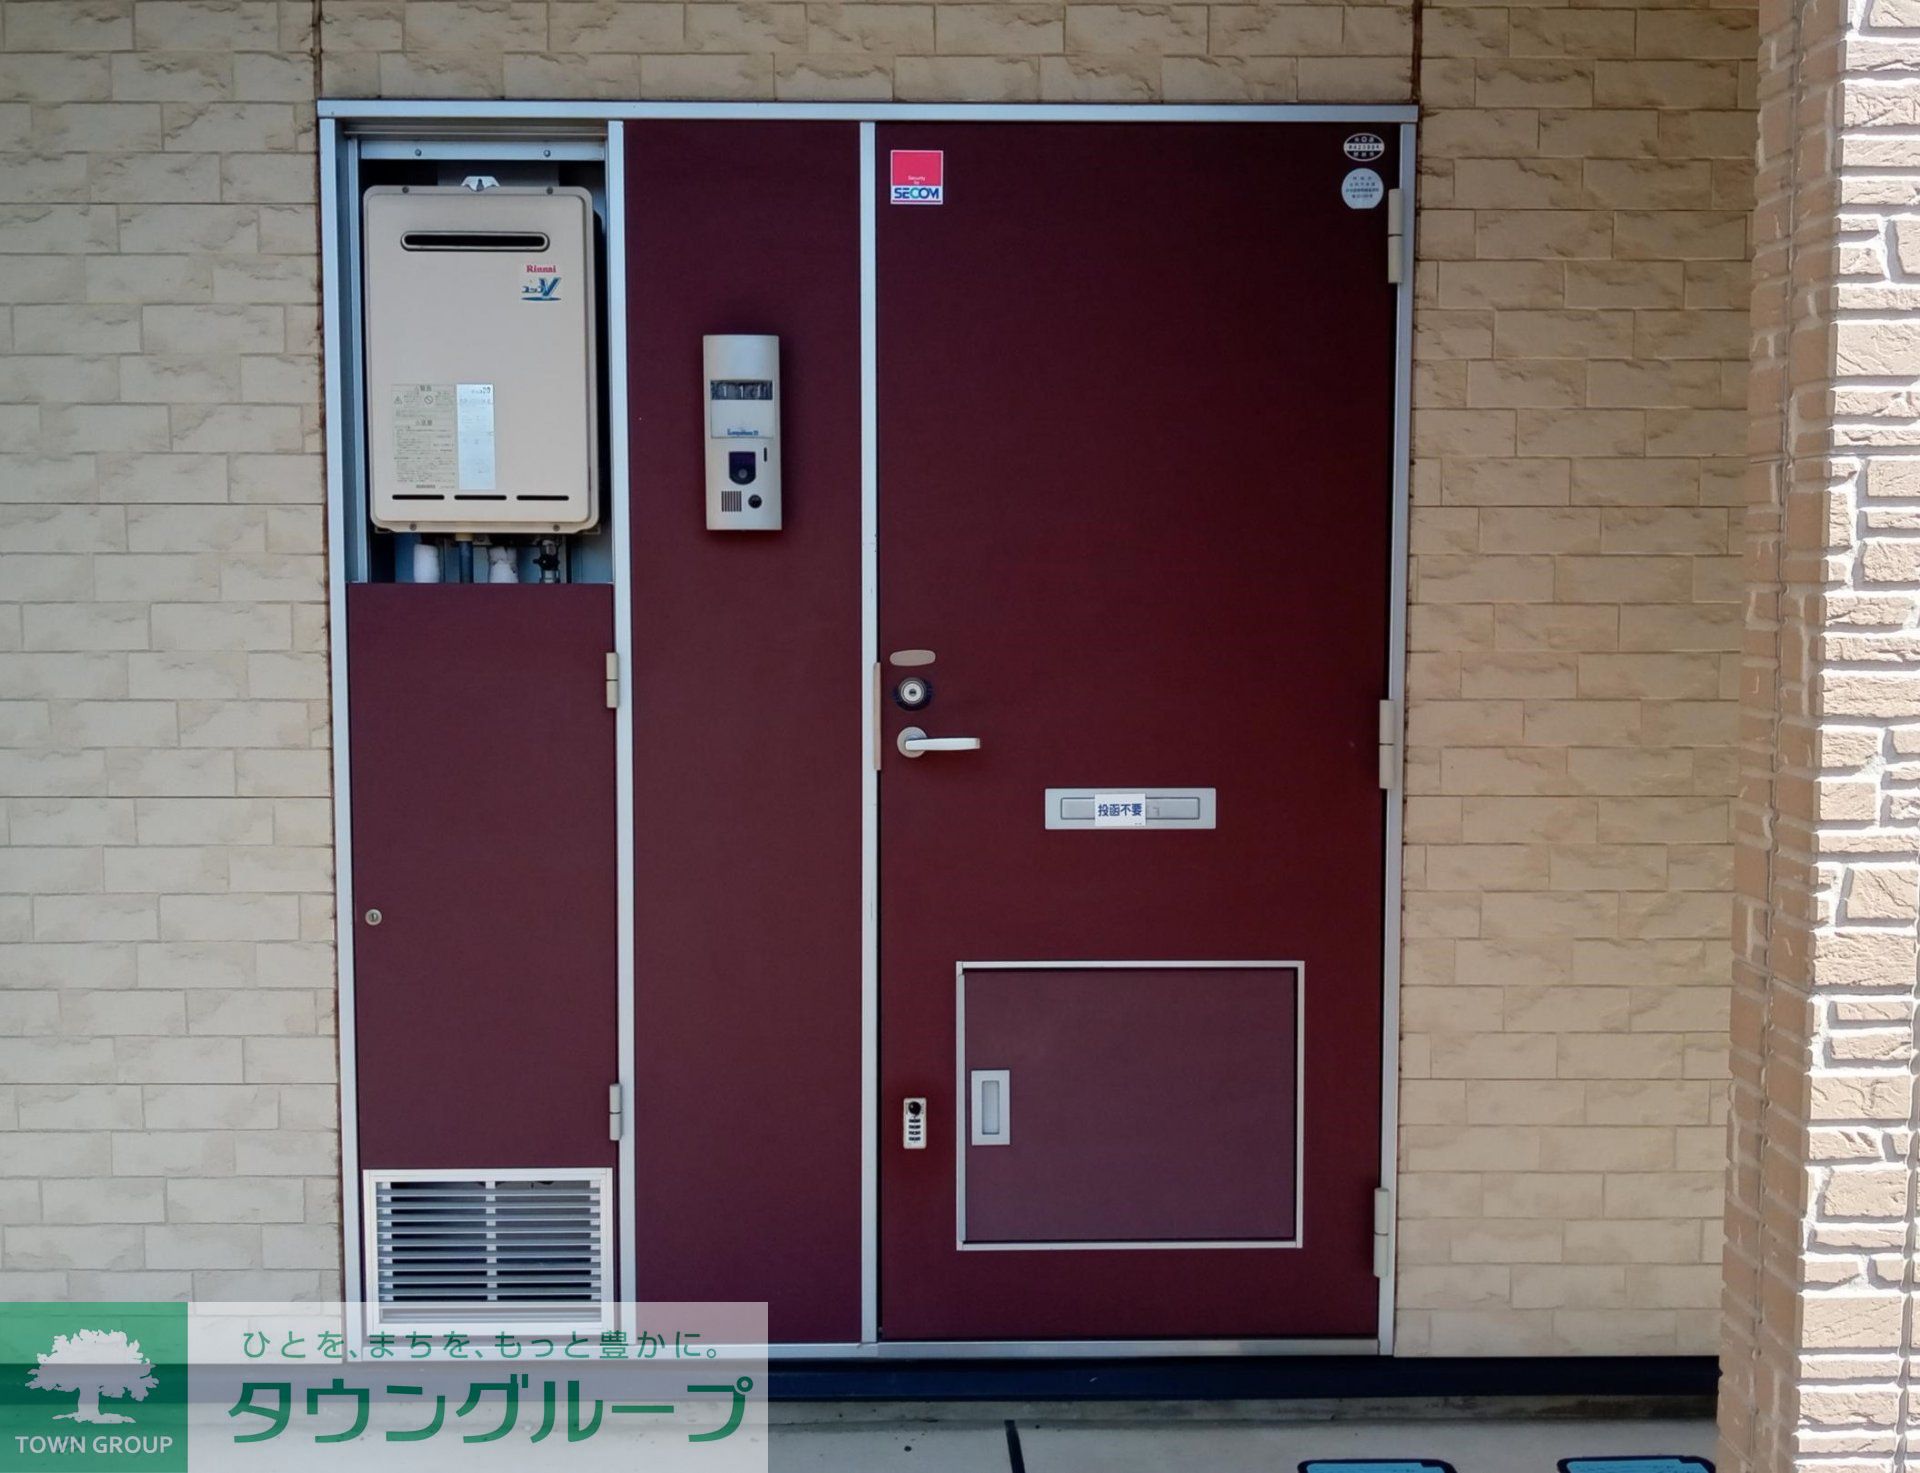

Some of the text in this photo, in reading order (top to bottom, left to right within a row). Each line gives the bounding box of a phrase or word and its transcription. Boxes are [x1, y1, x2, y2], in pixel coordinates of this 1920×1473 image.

[894, 187, 940, 199] SECOM
[526, 264, 557, 273] Rinnai
[1097, 803, 1143, 817] 投函不要
